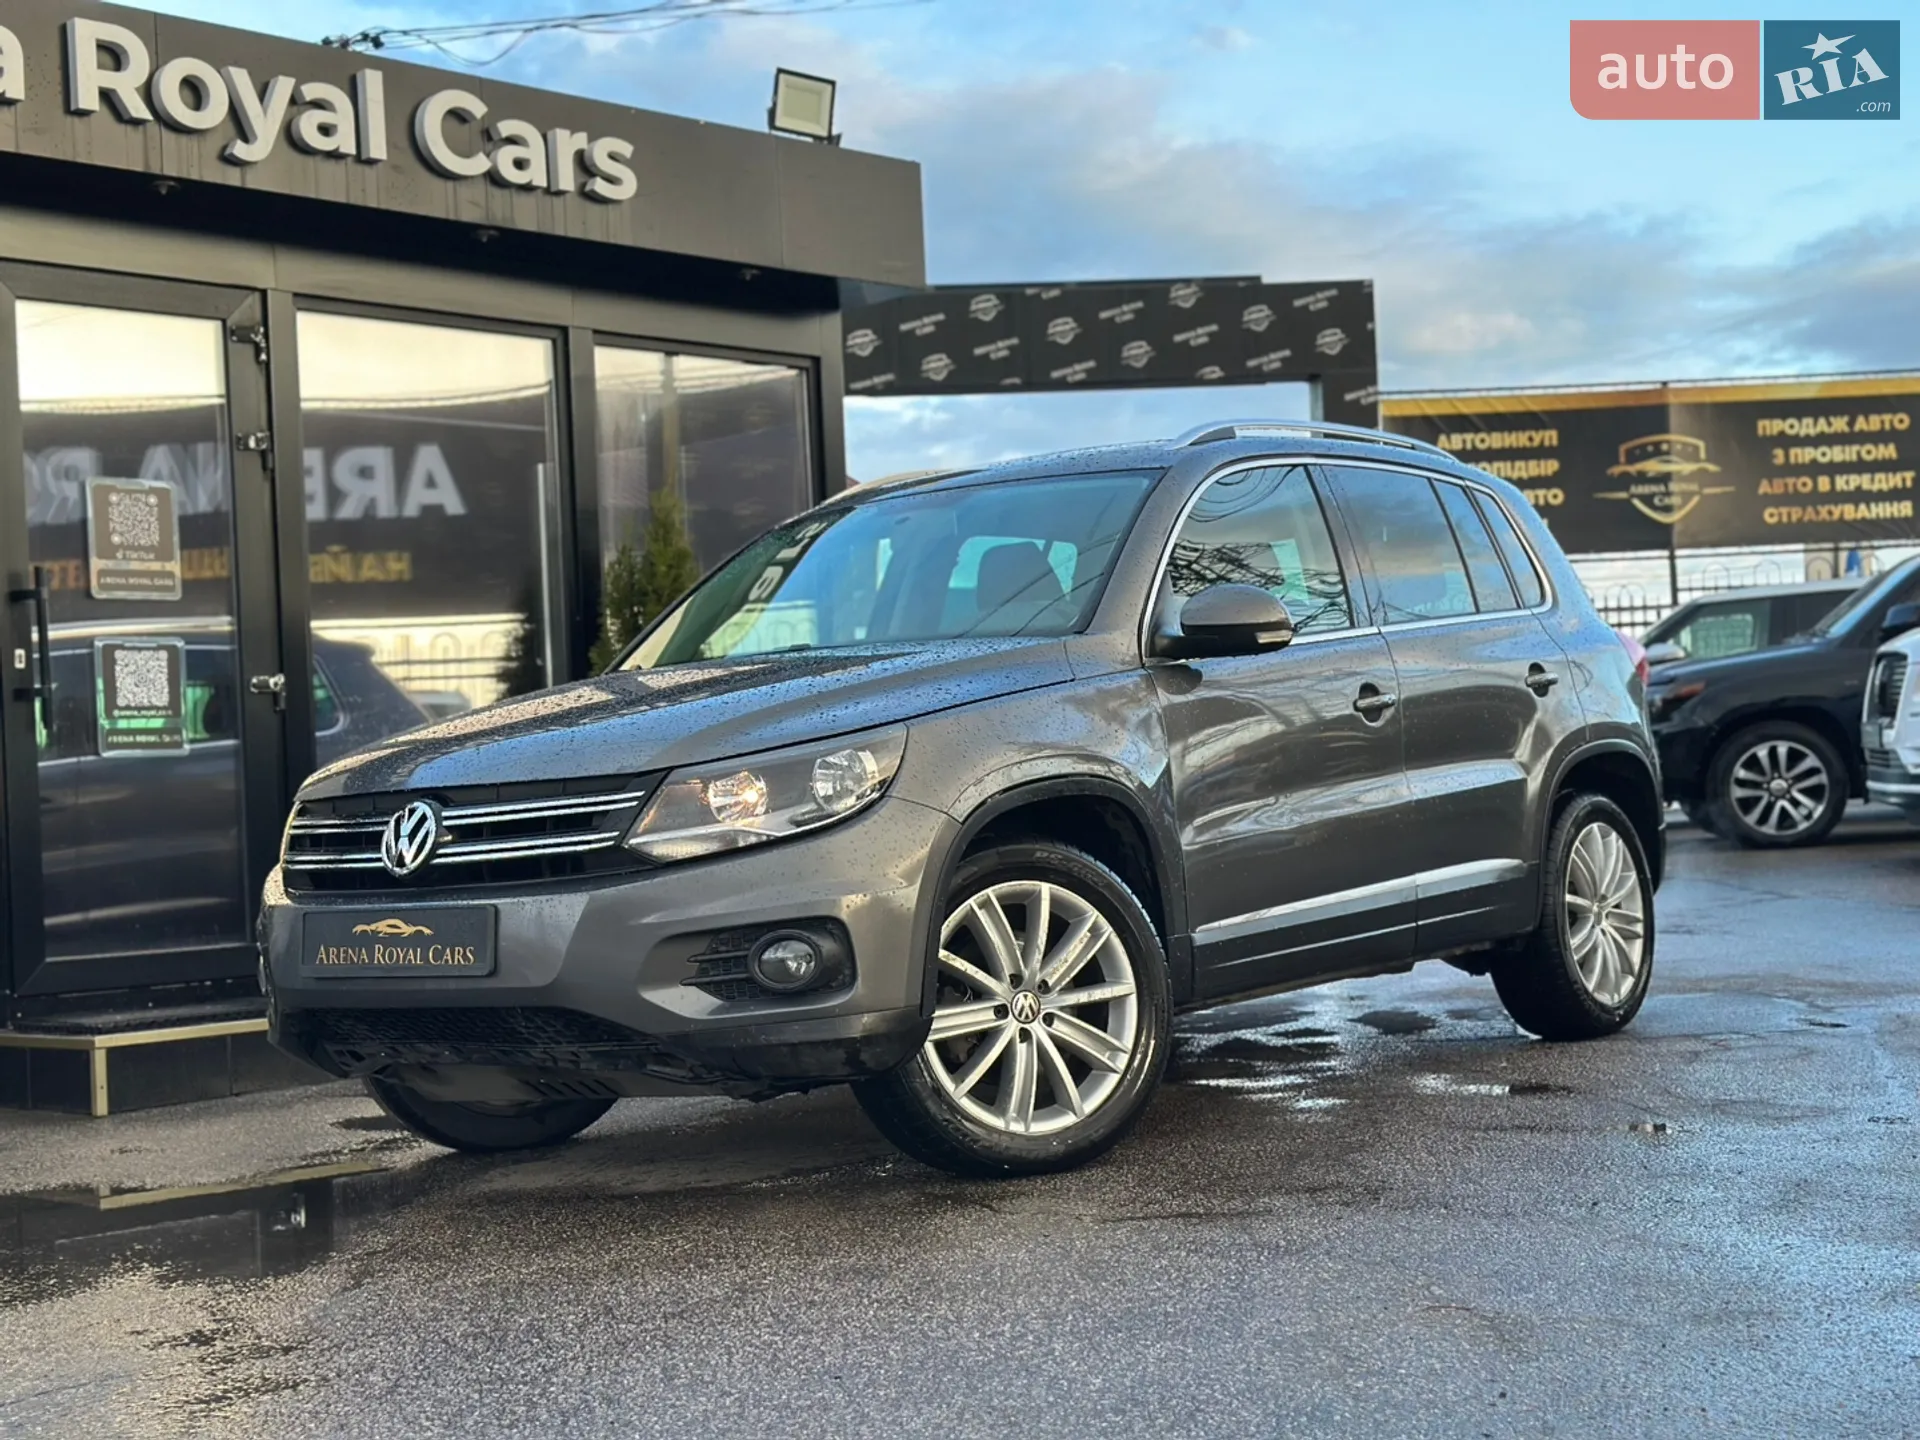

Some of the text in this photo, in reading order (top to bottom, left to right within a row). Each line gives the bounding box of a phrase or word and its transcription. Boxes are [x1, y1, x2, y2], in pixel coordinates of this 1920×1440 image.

[66, 16, 387, 166] Royal
[413, 88, 638, 202] Cars
[1757, 412, 1910, 437] ПРОДАЖ АВТО
[1436, 429, 1559, 451] АВТОВИКУП
[1789, 442, 1897, 464] ПРОБІГОМ
[1468, 458, 1560, 480] ОПІДБІР
[1758, 469, 1916, 494] АВТО В КРЕДИТ
[1523, 487, 1564, 506] ВТО
[1763, 500, 1913, 525] СТРАХУВАННЯ
[316, 944, 475, 965] ARENA ROYAL CARS
